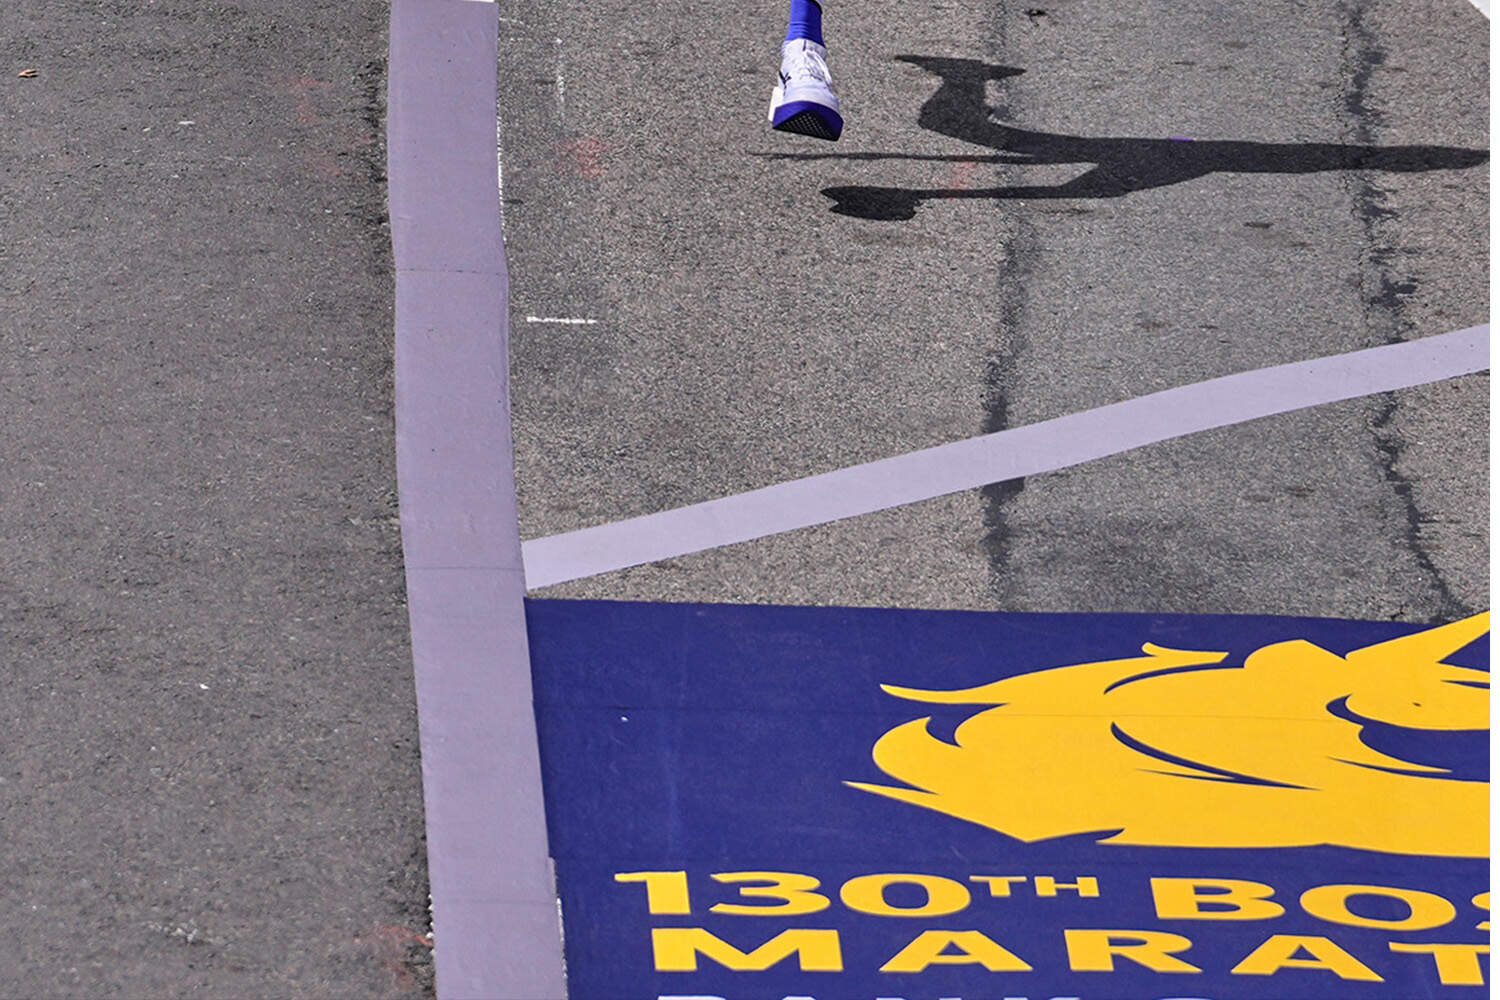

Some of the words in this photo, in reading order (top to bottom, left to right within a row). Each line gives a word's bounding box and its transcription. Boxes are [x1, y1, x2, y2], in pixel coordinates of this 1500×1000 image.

[614, 870, 1099, 917] 130TH
[1150, 877, 1490, 931] BO
[651, 927, 1490, 986] MARAT
